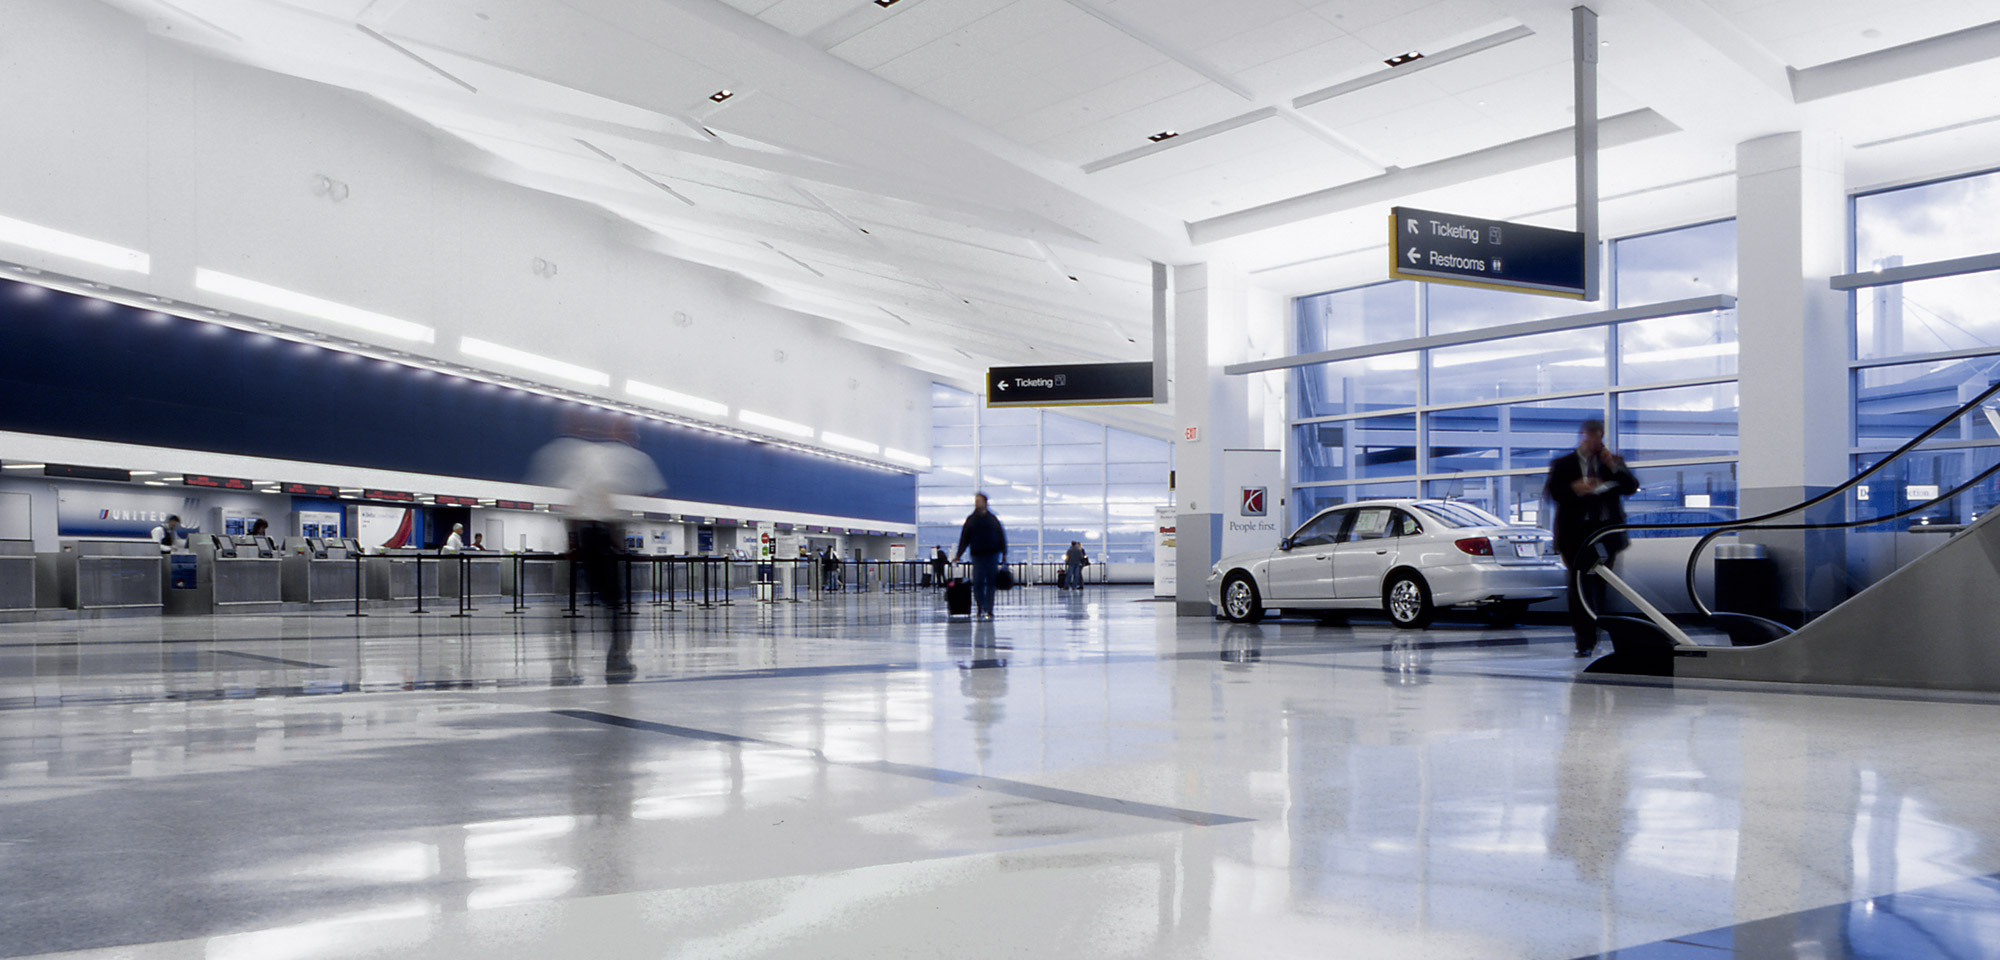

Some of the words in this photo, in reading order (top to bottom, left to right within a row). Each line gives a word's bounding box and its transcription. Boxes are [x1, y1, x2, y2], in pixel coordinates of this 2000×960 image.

[1429, 220, 1479, 244] Ticketing
[1429, 251, 1485, 271] Restrooms
[1015, 378, 1053, 388] Ticketing
[1186, 427, 1197, 440] EXIT
[112, 510, 167, 521] UNITED
[1229, 521, 1256, 533] People
